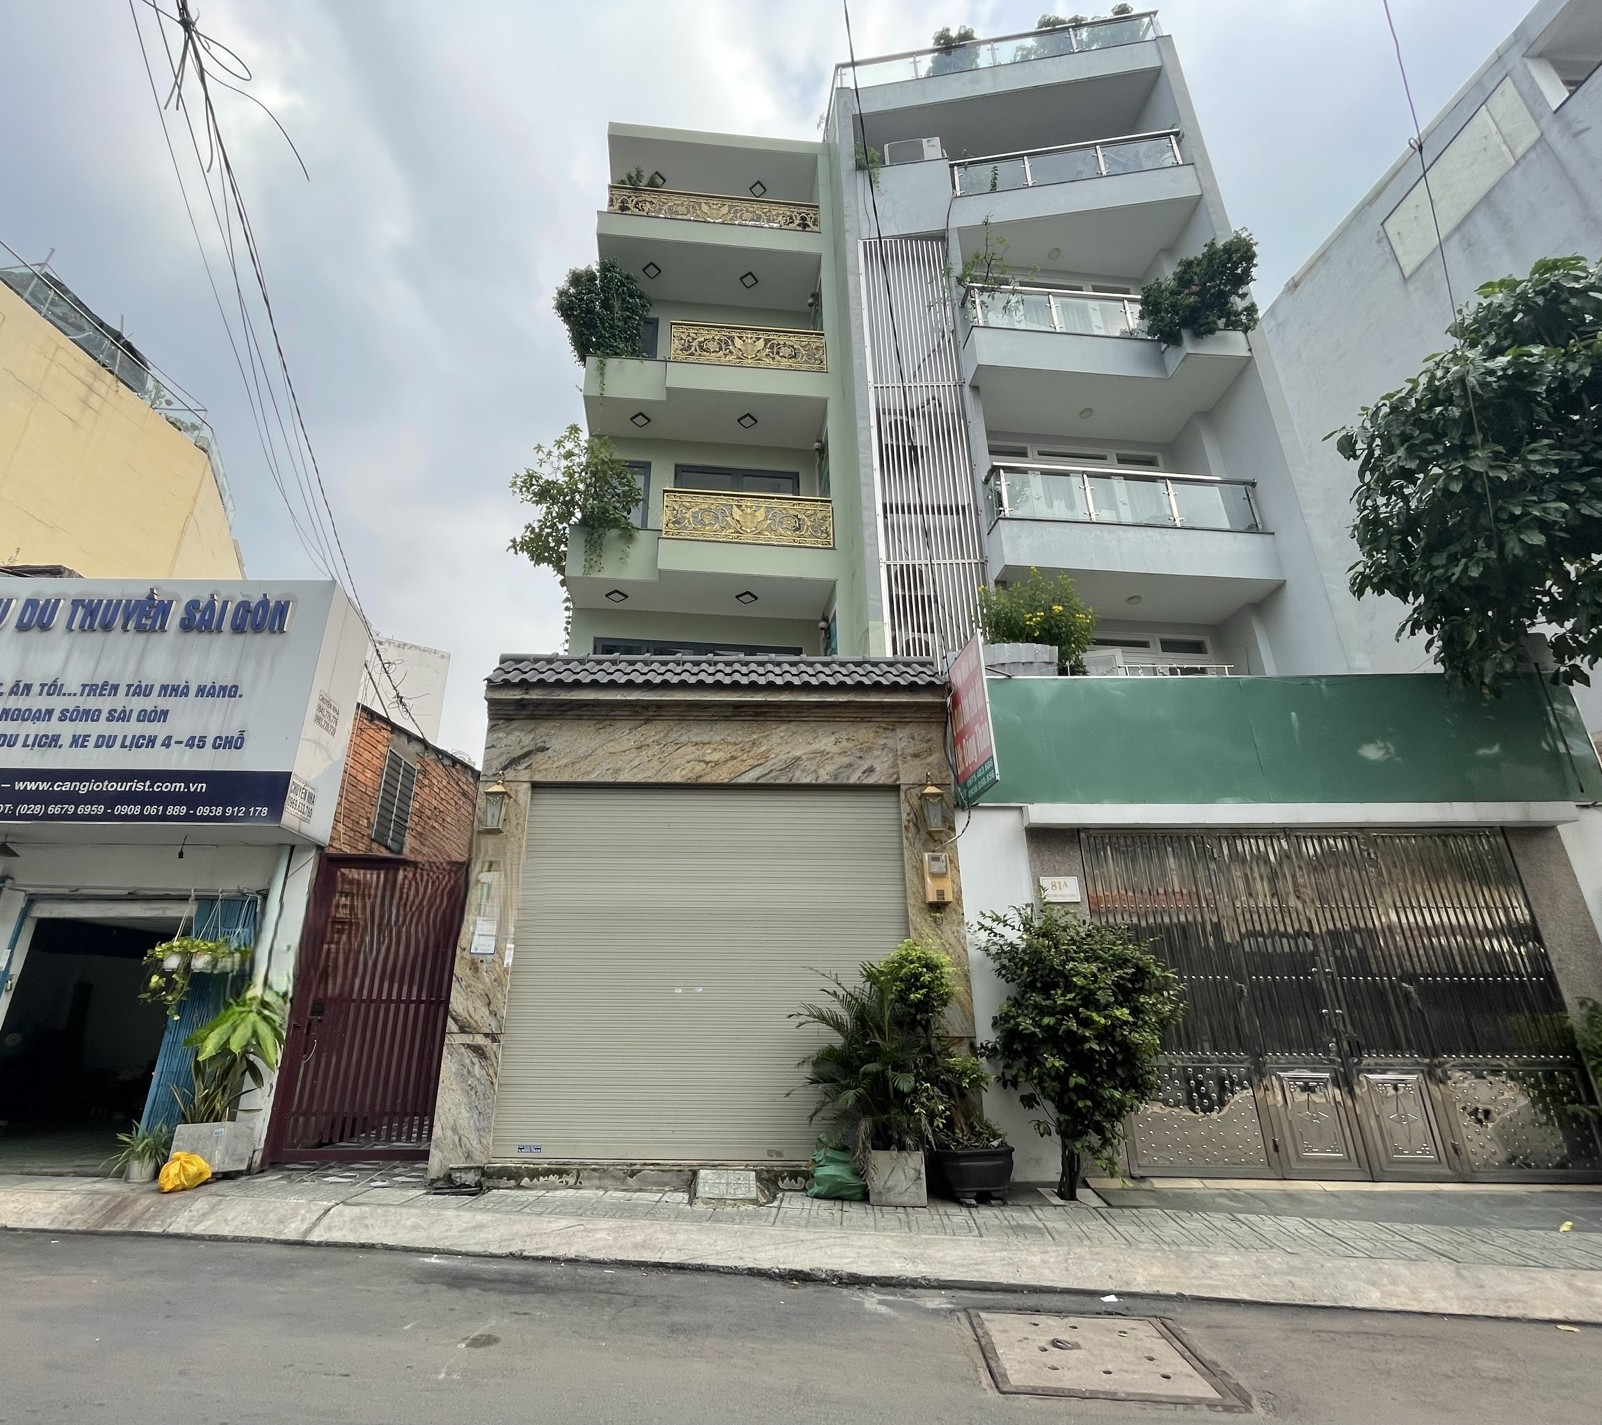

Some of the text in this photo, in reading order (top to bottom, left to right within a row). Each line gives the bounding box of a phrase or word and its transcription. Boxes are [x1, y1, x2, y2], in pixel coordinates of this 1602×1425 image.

[15, 598, 64, 632] DU
[65, 588, 177, 632] THUYỀN
[180, 593, 231, 632] SÀI
[230, 593, 292, 633] GÒN
[8, 680, 33, 697] ĂN
[124, 680, 155, 698] TÀU
[157, 680, 190, 698] NHÀ
[195, 681, 243, 698] HÀNG.
[0, 705, 170, 724] NGOẠN SÔNG SÀI GÒN
[69, 734, 91, 749] XE
[93, 734, 118, 749] DU
[120, 734, 158, 751] LỊCH
[211, 729, 246, 750] CHỖ
[14, 779, 207, 794] www.cangiotourist.com.vn
[16, 804, 45, 816] (028)
[47, 804, 75, 815] 6679
[77, 805, 105, 815] 6959
[114, 805, 141, 815] 0908
[143, 805, 164, 815] 061
[166, 806, 187, 815] 889
[196, 806, 222, 816] 0938
[225, 806, 246, 816] 912
[248, 806, 269, 817] 178
